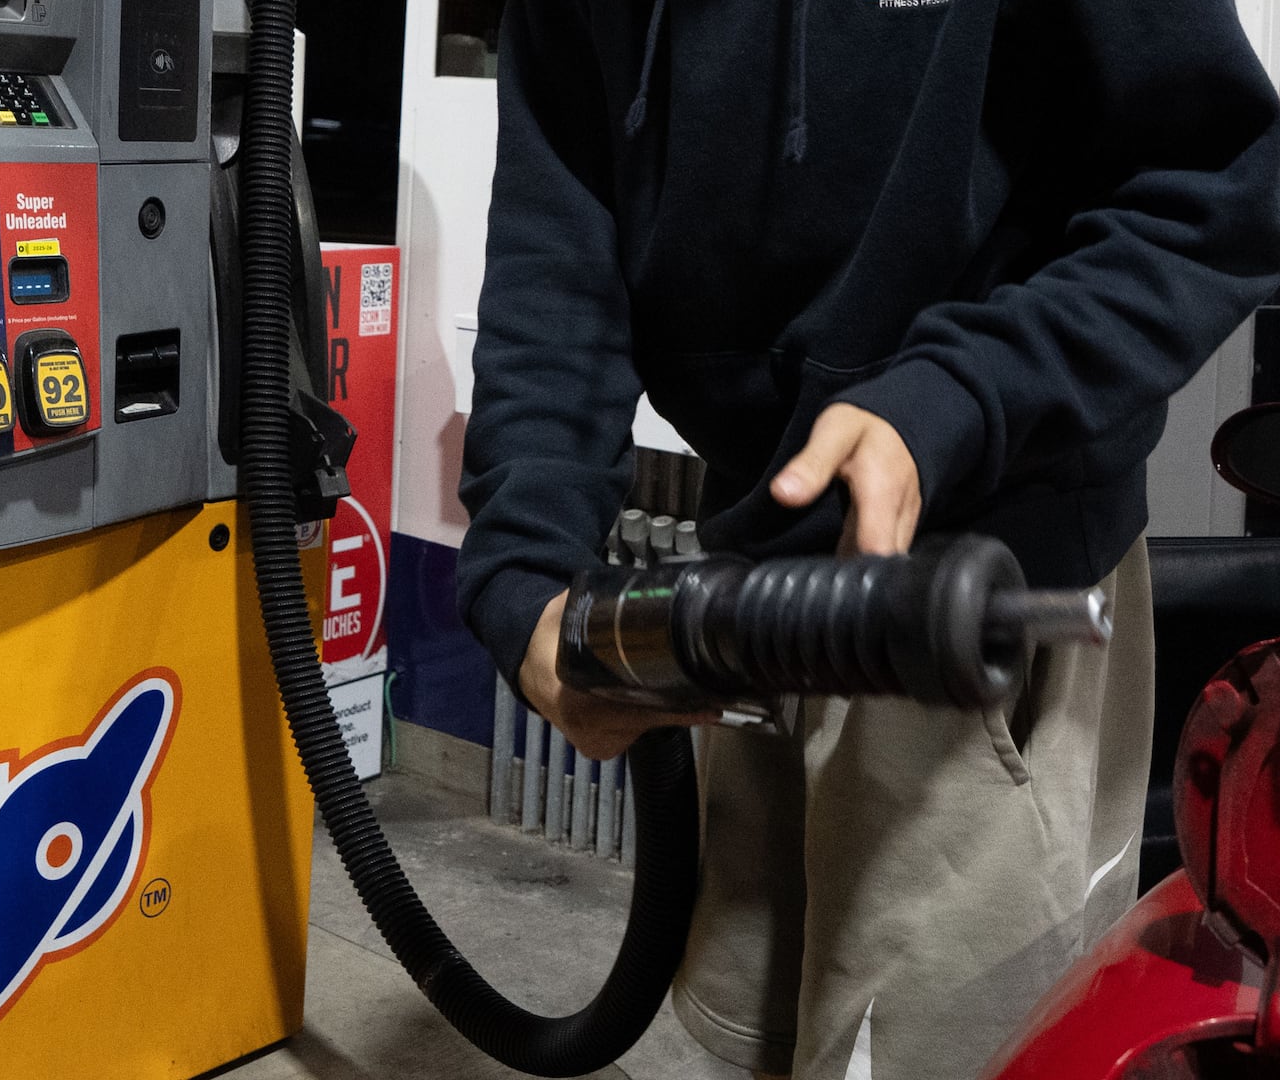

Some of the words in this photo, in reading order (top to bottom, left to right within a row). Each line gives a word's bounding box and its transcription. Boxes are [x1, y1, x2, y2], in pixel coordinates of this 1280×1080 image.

[16, 193, 54, 213] Super
[5, 212, 67, 230] Unleaded
[43, 374, 82, 404] 92
[66, 407, 80, 415] HERE
[323, 610, 362, 641] UCHES
[144, 884, 167, 909] TM
